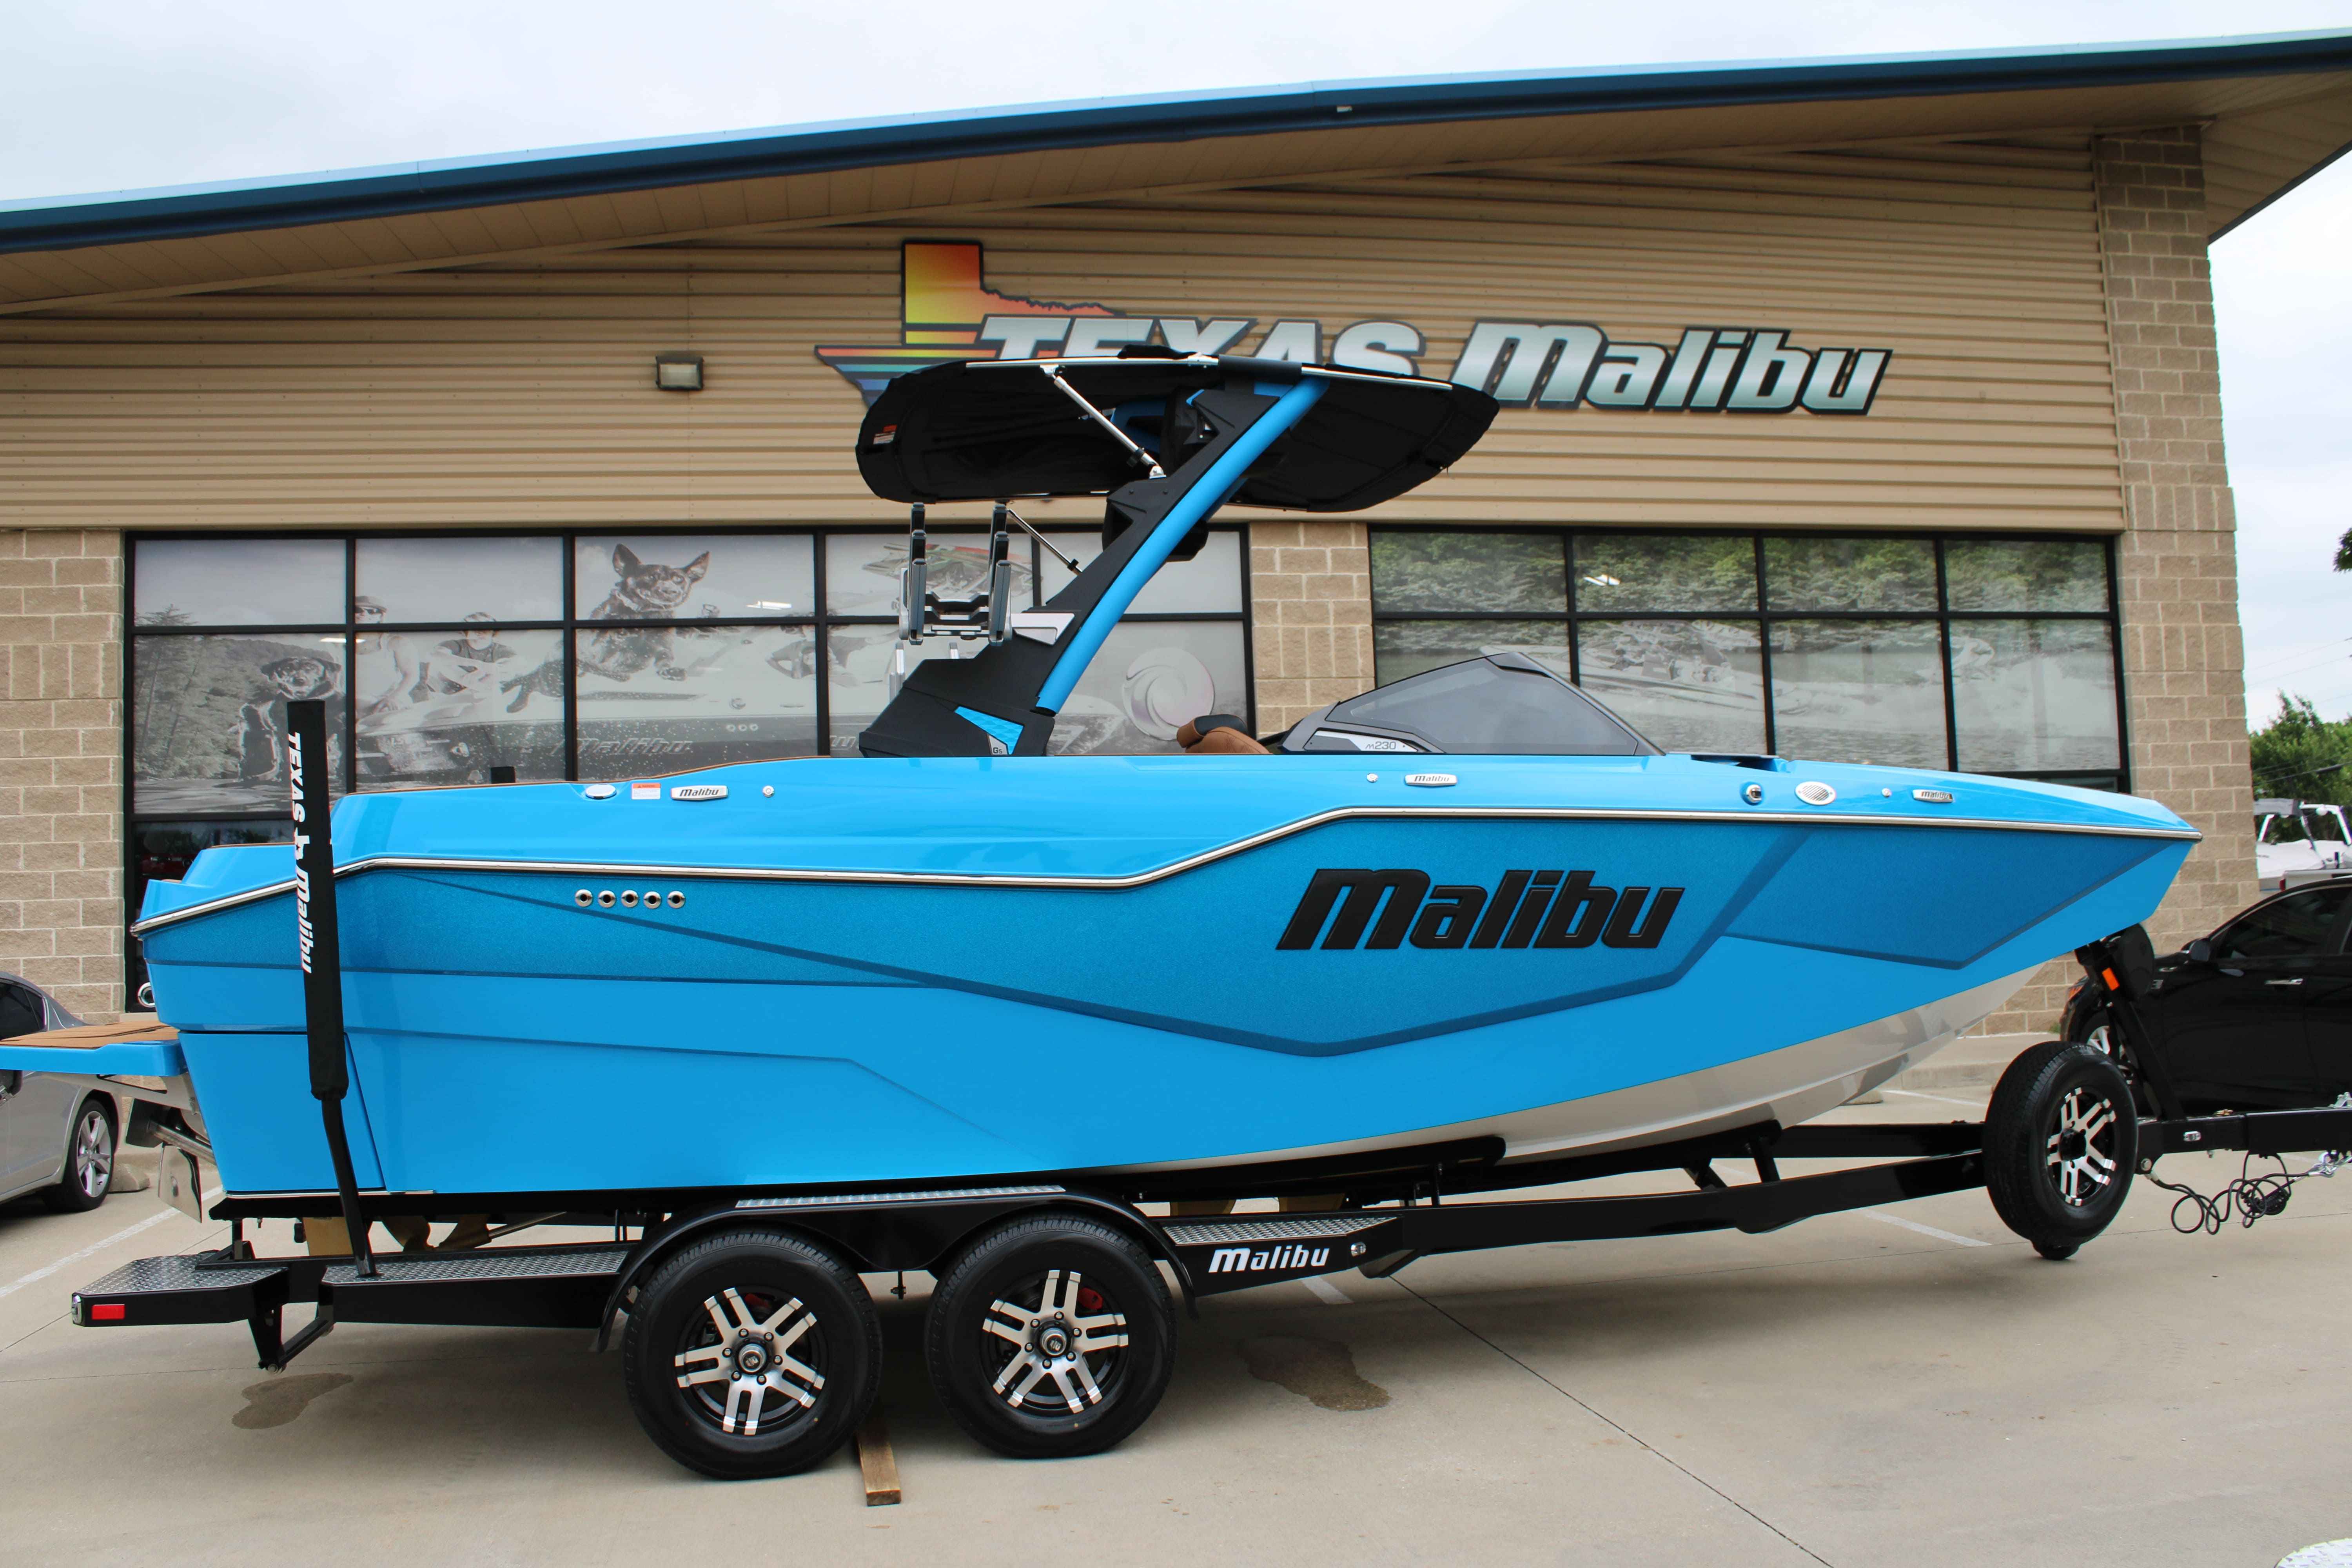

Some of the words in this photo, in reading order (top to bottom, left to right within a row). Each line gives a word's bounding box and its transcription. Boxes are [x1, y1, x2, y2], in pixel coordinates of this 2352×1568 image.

[1450, 319, 1892, 415] Malibu
[287, 731, 306, 823] TEXAS
[679, 788, 720, 797] Malibu
[296, 864, 314, 974] Malibu
[1275, 868, 1685, 950] Malibu
[1208, 1244, 1330, 1273] Malibu
